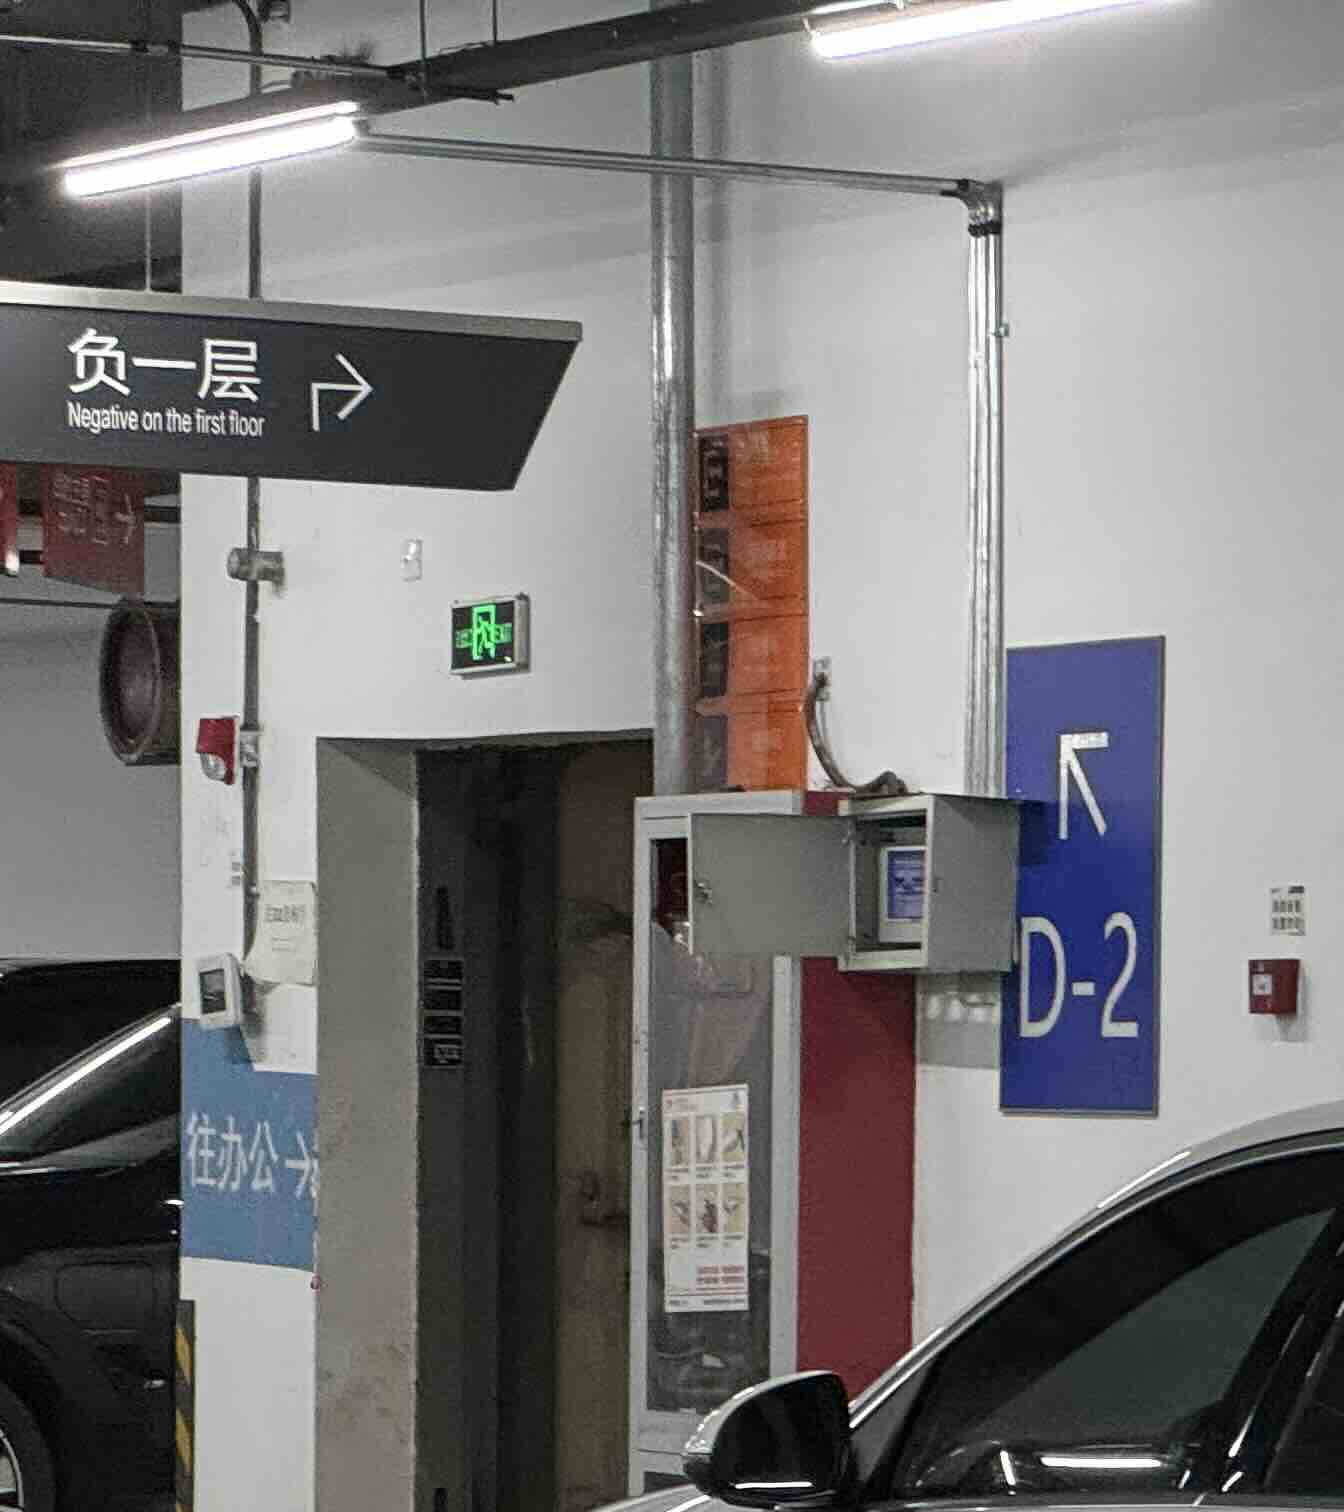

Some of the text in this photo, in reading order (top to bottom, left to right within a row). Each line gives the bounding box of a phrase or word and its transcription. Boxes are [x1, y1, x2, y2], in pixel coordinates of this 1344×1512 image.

[67, 328, 261, 402] 负一层
[67, 402, 265, 437] Negative on the first floor
[1020, 912, 1139, 1038] D-2
[186, 1113, 279, 1193] 往办公
